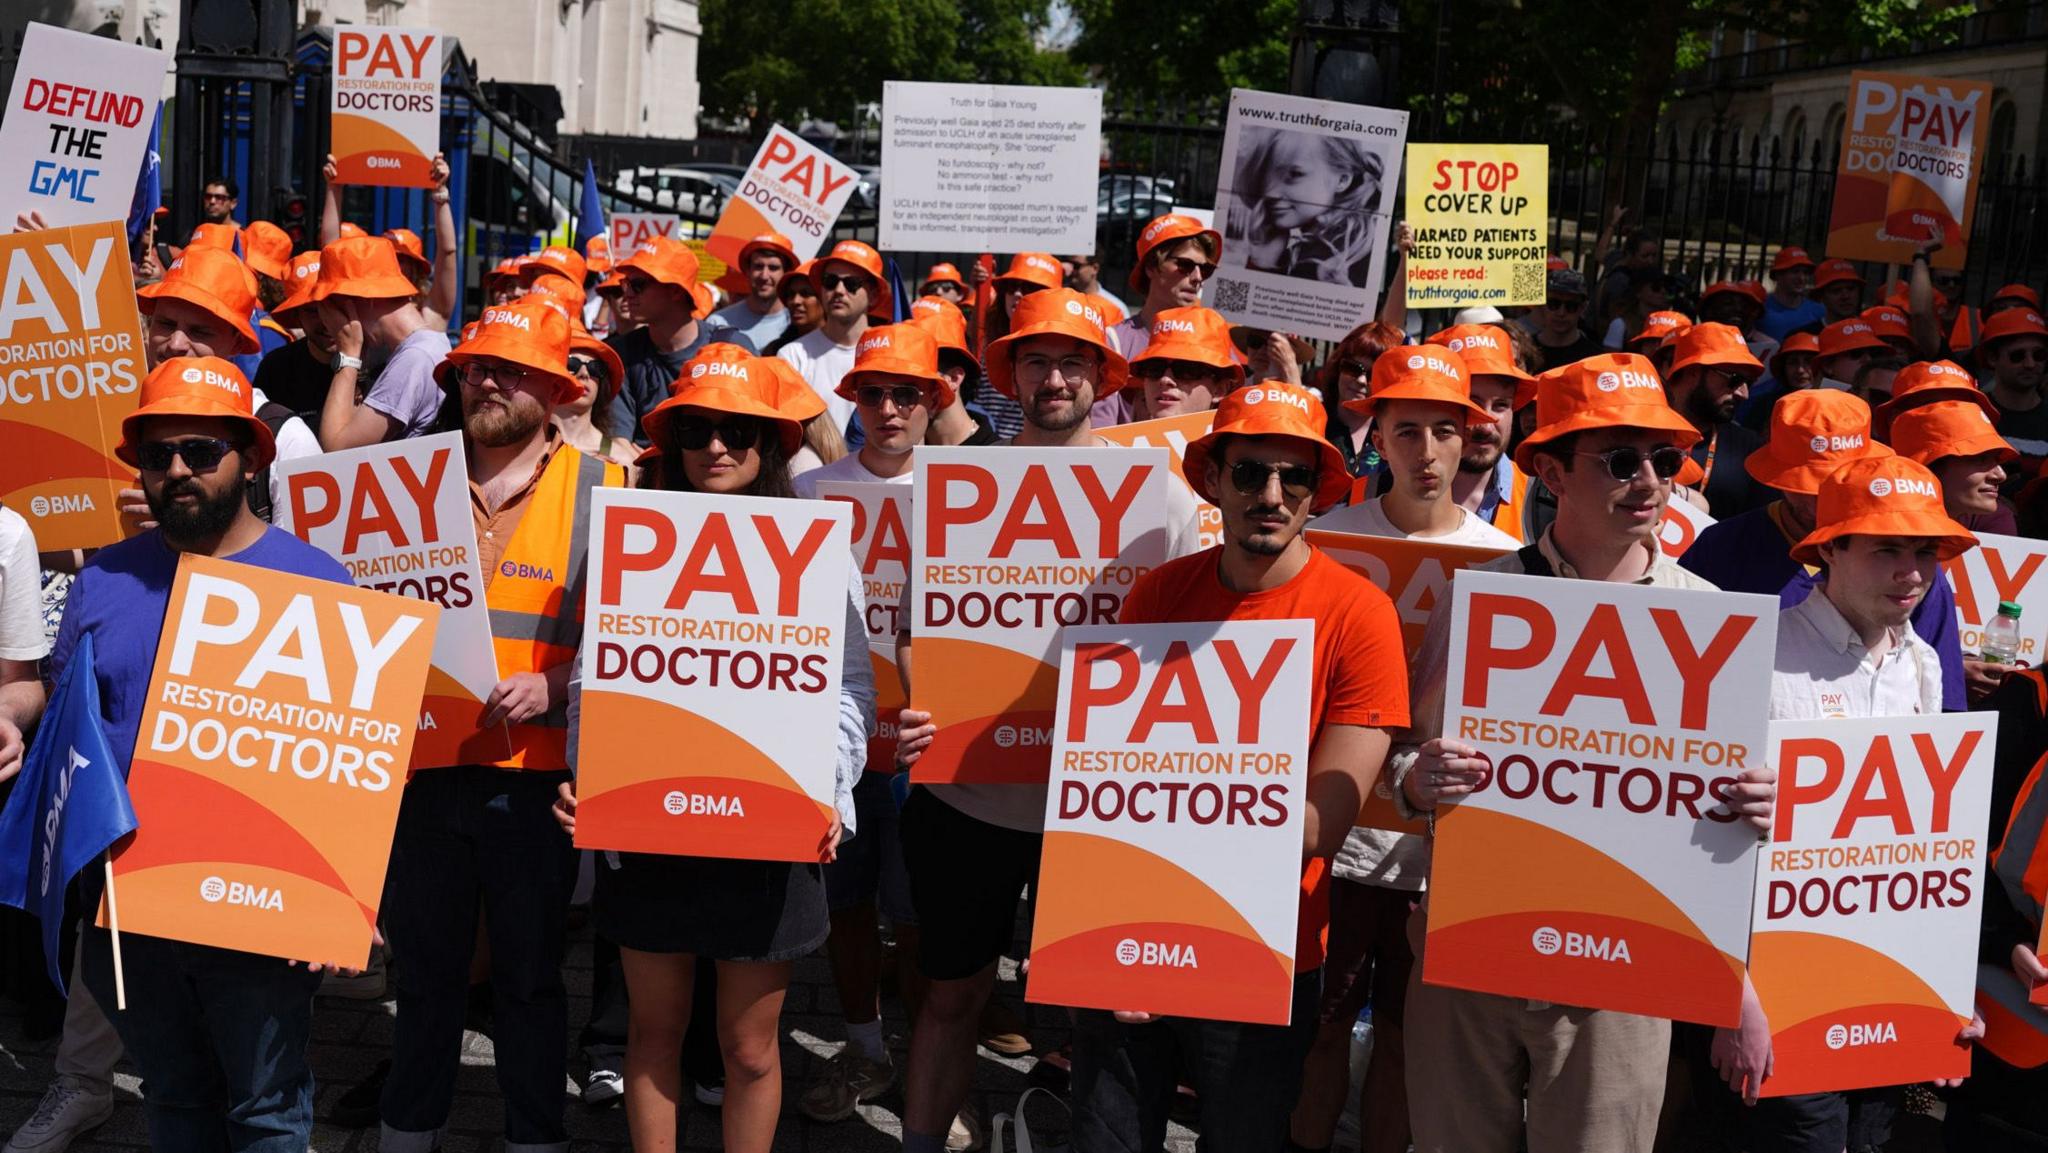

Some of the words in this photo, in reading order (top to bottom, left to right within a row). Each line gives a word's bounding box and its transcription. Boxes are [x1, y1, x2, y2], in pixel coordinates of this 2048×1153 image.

[338, 32, 435, 79] PAY
[337, 79, 411, 92] RESTORATION
[413, 82, 434, 92] FOR
[24, 78, 144, 128] DEFUND
[337, 92, 434, 112] DOCTORS
[950, 97, 972, 106] Truth
[974, 98, 985, 107] for
[987, 98, 1007, 107] Gaia
[1010, 99, 1037, 110] Young
[894, 116, 937, 127] Previously
[941, 117, 956, 126] well
[959, 118, 979, 126] Gaia
[981, 118, 1001, 129] aged
[1003, 119, 1014, 127] 25
[1017, 119, 1034, 128] died
[1037, 120, 1064, 131] shortly
[1067, 121, 1085, 129] after
[894, 128, 936, 136] admission
[938, 129, 947, 137] to
[949, 129, 975, 137] UCLH
[977, 130, 985, 138] of
[1000, 131, 1022, 139] acute
[1025, 131, 1076, 142] unexplained
[1238, 107, 1398, 137] www.truthforgaia.com
[1902, 97, 1972, 148] PAY
[50, 123, 107, 160] THE
[1004, 143, 1021, 151] She
[378, 158, 401, 168] BMA
[758, 134, 852, 206] PAY
[937, 159, 949, 167] No
[952, 160, 999, 170] fundoscopy
[1007, 161, 1023, 171] why
[937, 171, 949, 179] No
[991, 172, 1007, 180] test
[1015, 173, 1032, 183] why
[1433, 160, 1519, 193] STOP
[1898, 152, 1964, 180] DOCTORS
[29, 160, 99, 203] GMC
[947, 183, 961, 191] this
[983, 184, 1021, 194] practice?
[742, 181, 824, 238] DOCTORS
[751, 170, 812, 209] RESTORATION
[811, 206, 832, 222] FOR
[893, 199, 919, 208] UCLH
[921, 200, 937, 208] and
[988, 202, 1024, 212] opposed
[1056, 204, 1087, 214] request
[1424, 194, 1492, 214] COVER
[1501, 196, 1528, 216] UP
[893, 211, 904, 219] for
[919, 212, 970, 223] independent
[973, 213, 1019, 224] neurologist
[1021, 214, 1028, 222] in
[1056, 215, 1079, 225] Why?
[902, 223, 917, 231] this
[960, 224, 1007, 235] transparent
[1009, 226, 1066, 236] investigation?
[614, 219, 673, 248] PAY
[1474, 228, 1537, 243] PATIENTS
[1408, 246, 1442, 260] NEED
[1446, 246, 1482, 260] YOUR
[1488, 246, 1546, 260] SUPPORT
[0, 237, 114, 339] AY
[1408, 266, 1448, 282] please
[1453, 266, 1488, 280] read:
[1408, 284, 1506, 303] truthforgaia.com
[495, 310, 530, 332] BMA
[1164, 320, 1194, 333] BMA
[0, 337, 84, 365] ORATION
[90, 332, 132, 355] FOR
[864, 335, 891, 352] BMA
[1465, 336, 1498, 350] BMA
[0, 358, 138, 406] CTORS
[708, 362, 750, 382] BMA
[1426, 356, 1460, 380] BMA
[1621, 370, 1662, 392] BMA
[204, 369, 242, 397] BMA
[1268, 388, 1309, 414] BMA
[1830, 434, 1864, 451] BMA
[288, 448, 452, 556] PAY
[1894, 478, 1937, 499] BMA
[50, 494, 96, 514] BMA
[925, 463, 1154, 559] PAY
[1199, 508, 1222, 526] FO
[824, 494, 912, 582] PA
[341, 551, 424, 578] ORATION
[428, 546, 468, 569] FOR
[518, 564, 554, 582] BMA
[600, 505, 837, 618] PAY
[925, 564, 1096, 586] RESTORATION
[362, 572, 474, 610] TORS
[1942, 546, 2047, 626] AY
[924, 592, 1127, 628] DOCTOR
[168, 572, 424, 711] PAY
[598, 613, 774, 644] RESTORATION
[780, 624, 830, 648] FOR
[596, 642, 828, 694] DOCTORS
[1462, 591, 1758, 731] PAY
[1066, 638, 1298, 745] PAY
[1821, 694, 1842, 704] PAY
[161, 681, 345, 736] RESTORATION
[348, 717, 402, 746] FOR
[880, 720, 901, 739] BM
[1020, 727, 1054, 746] BM
[1459, 716, 1674, 762] RESTORATION
[1682, 740, 1748, 769] FOR
[151, 710, 394, 792] DOCTORS
[1063, 750, 1233, 776] RESTORATION
[1240, 752, 1292, 776] FOR
[1772, 730, 1984, 843] PAY
[690, 794, 745, 818] BMA
[1058, 780, 1289, 828] DOCTORS
[1770, 842, 1928, 872] RESTORATION
[1932, 838, 1976, 862] FOR
[227, 881, 284, 912] BMA
[1766, 867, 1972, 920] DOCTORS
[1142, 942, 1198, 970] BMA
[1565, 932, 1632, 964] BMA
[1849, 1022, 1897, 1048] BMA
